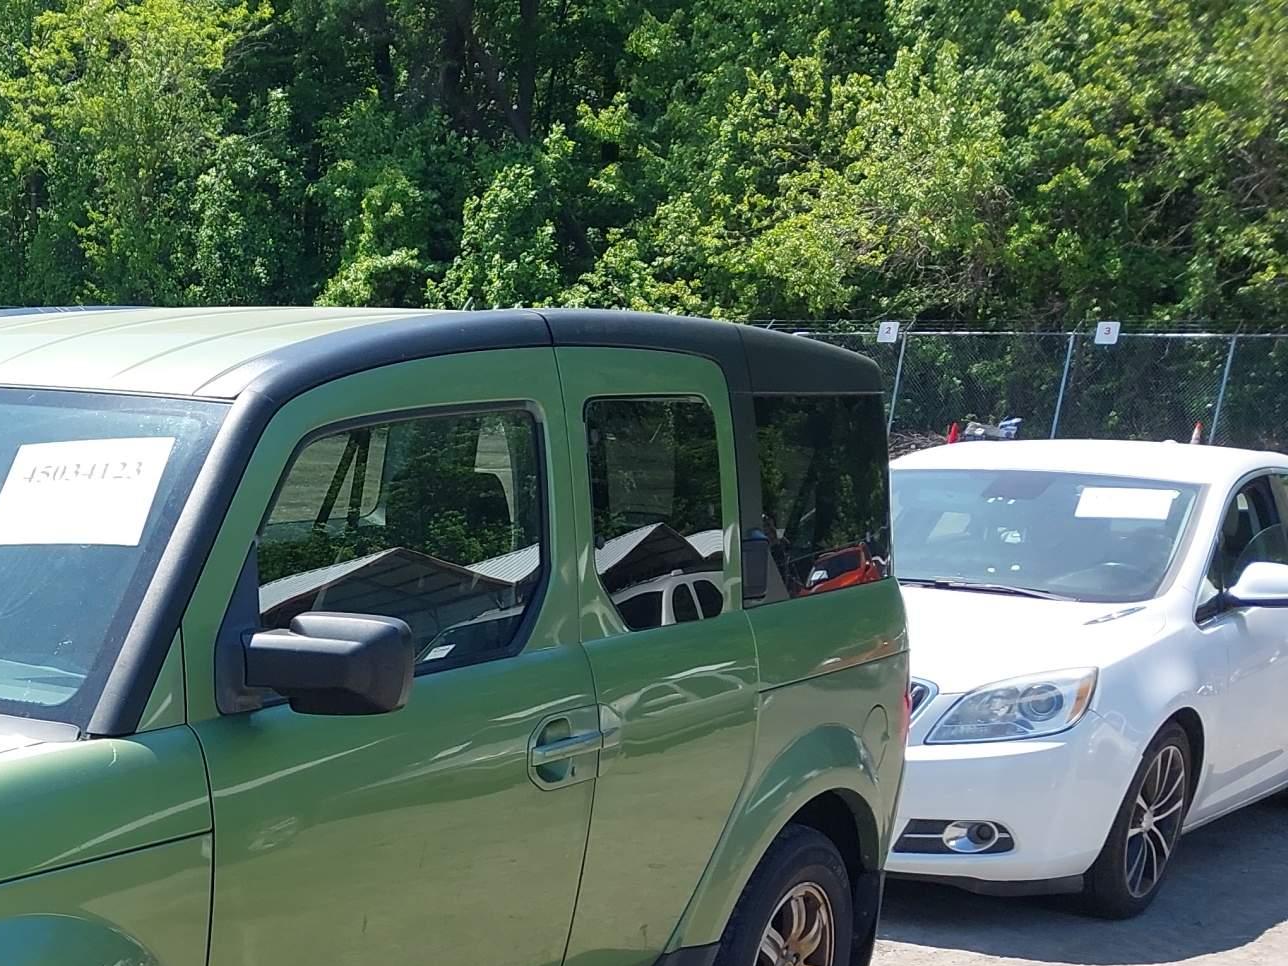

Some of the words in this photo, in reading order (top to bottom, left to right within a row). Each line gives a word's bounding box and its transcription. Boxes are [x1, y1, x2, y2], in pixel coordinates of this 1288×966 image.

[884, 326, 892, 335] 2
[1103, 326, 1112, 336] 3
[23, 461, 144, 483] 45034123
